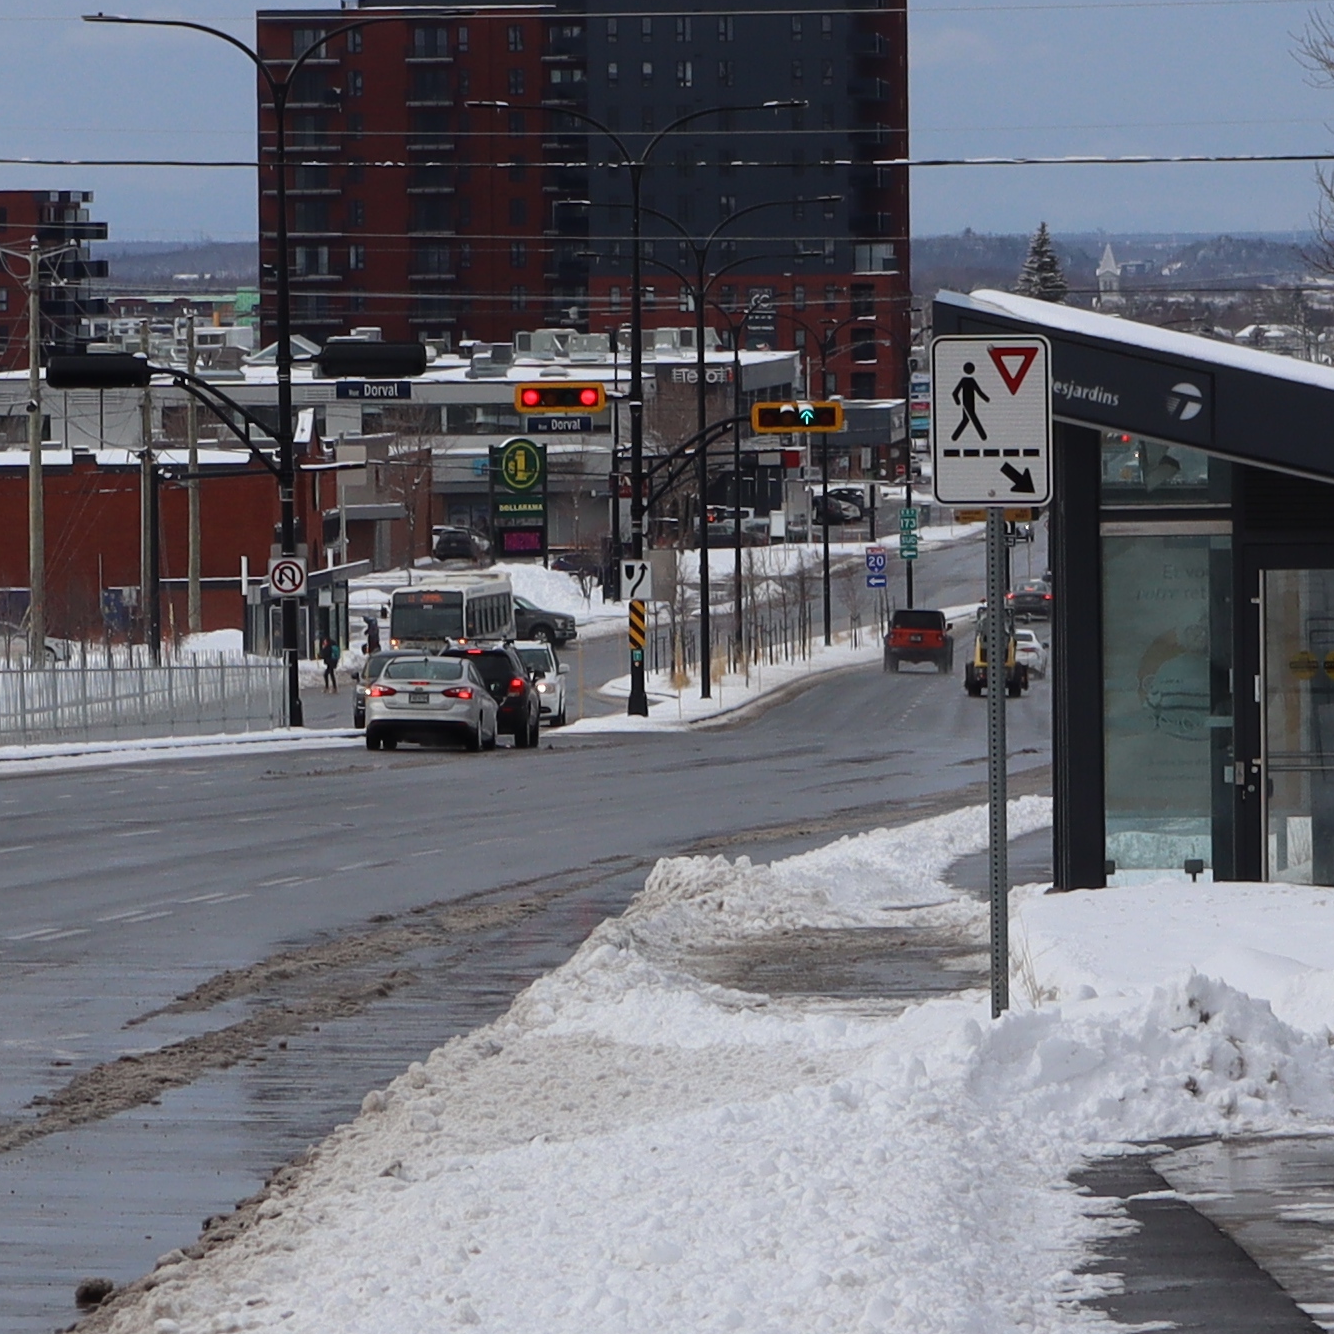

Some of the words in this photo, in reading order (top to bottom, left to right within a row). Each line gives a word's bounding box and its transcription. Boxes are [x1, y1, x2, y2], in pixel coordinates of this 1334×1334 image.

[364, 383, 398, 397] Dorval
[1052, 376, 1120, 407] esjardins
[551, 418, 581, 431] Dorval
[499, 504, 544, 512] DOLLARAMA
[900, 519, 916, 529] 173
[868, 556, 884, 567] 20
